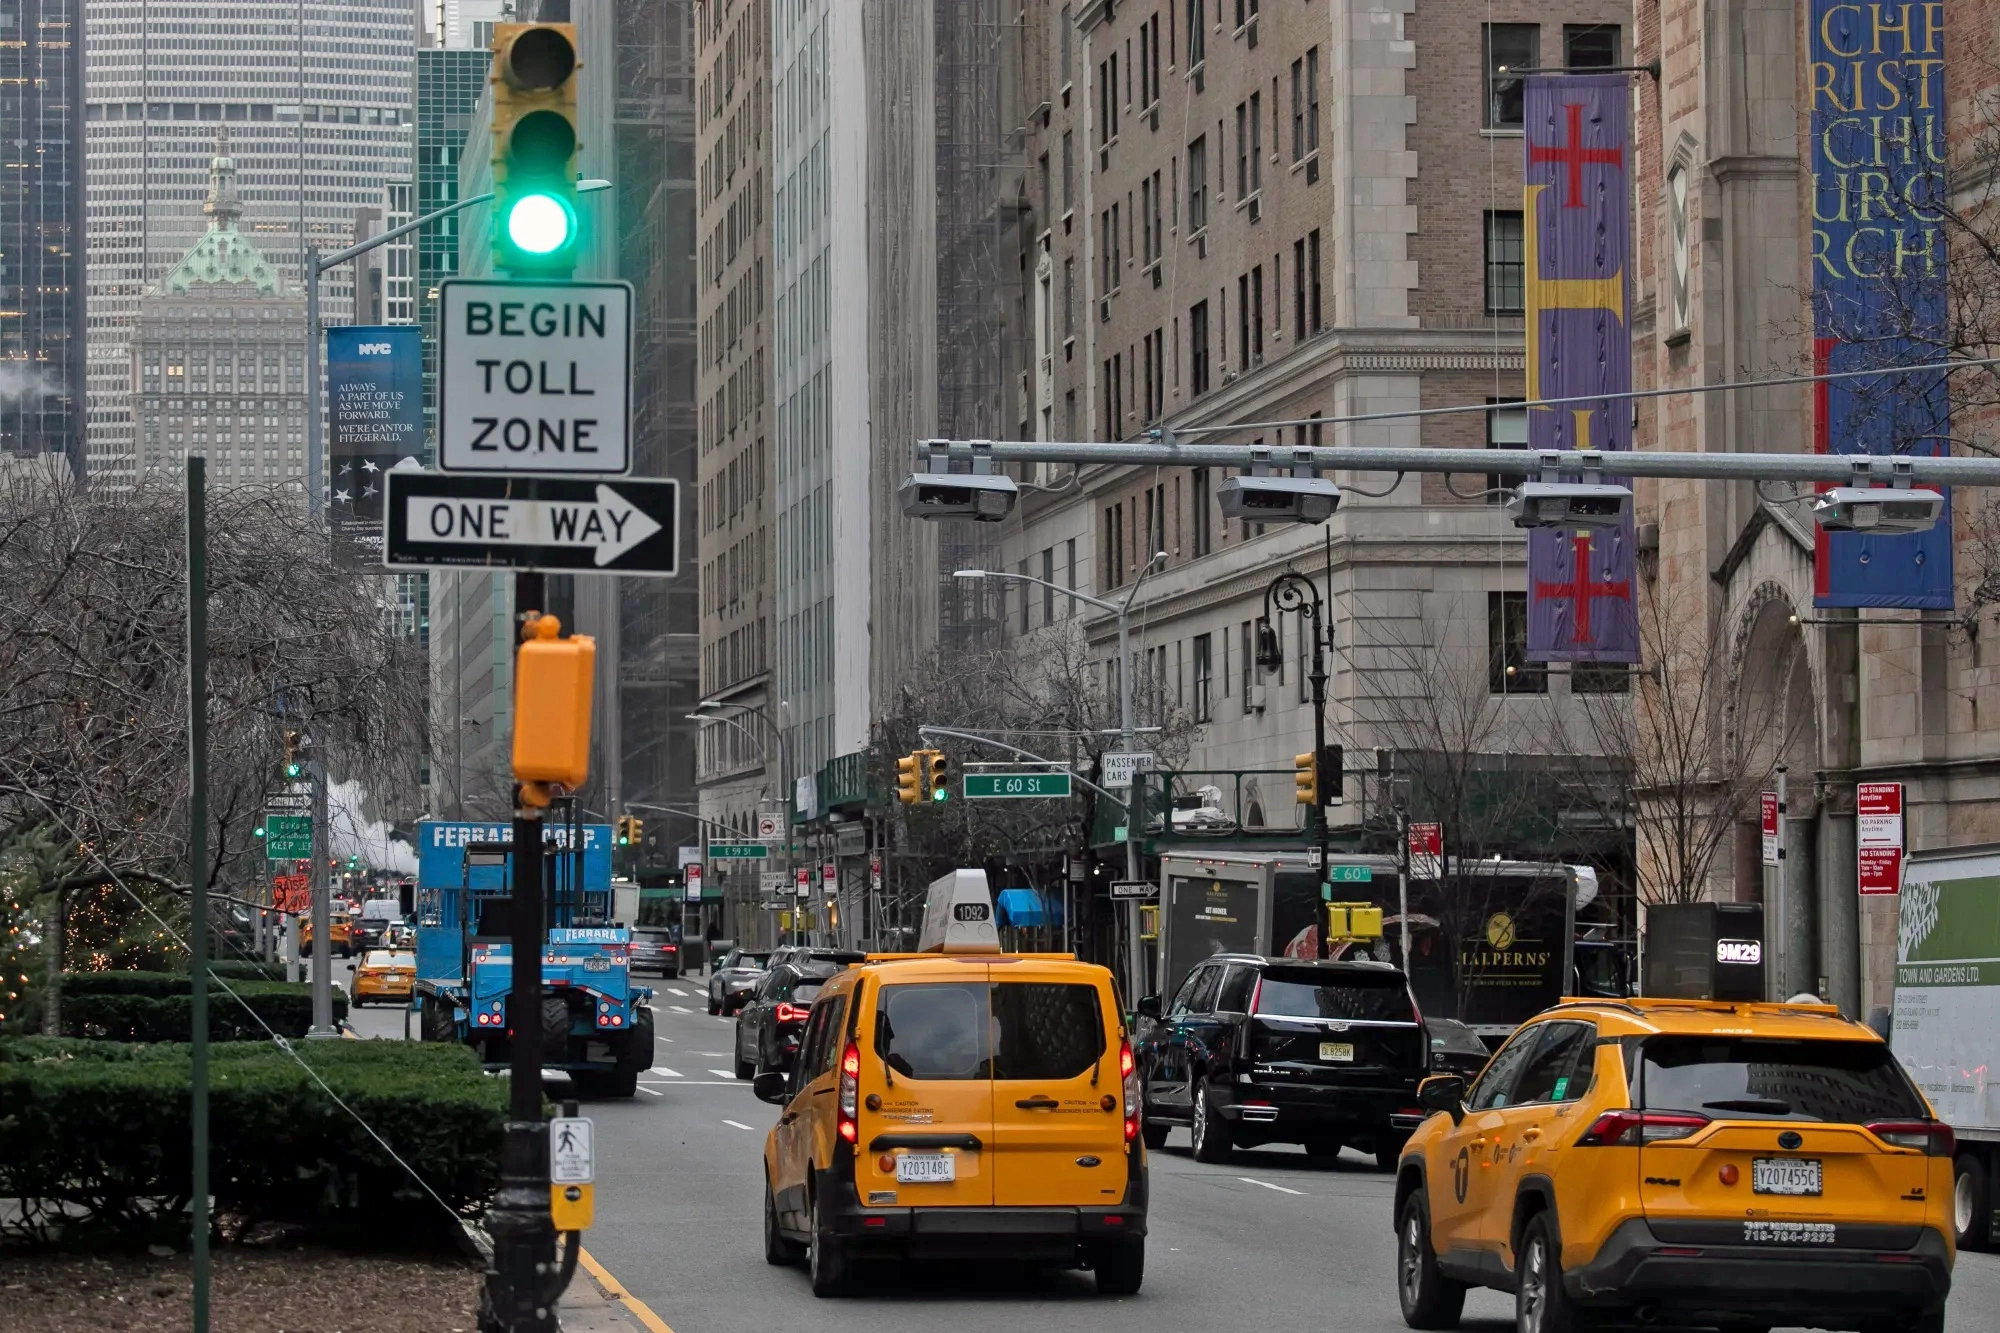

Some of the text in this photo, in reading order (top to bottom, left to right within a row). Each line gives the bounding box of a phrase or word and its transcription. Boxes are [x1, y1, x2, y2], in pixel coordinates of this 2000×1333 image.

[1811, 59, 1944, 112] RIST
[1812, 171, 1945, 222] URC
[1812, 227, 1938, 280] RCH
[466, 302, 606, 338] BEGIN
[358, 343, 392, 355] NYC
[476, 360, 595, 396] TOLL
[338, 382, 376, 392] ALWAYS
[338, 392, 404, 402] A PART OF US
[339, 401, 401, 411] AS WE MOVE
[339, 410, 391, 420] FORWARD.
[339, 423, 414, 433] WE'RE CANTOR
[339, 433, 402, 443] FITZGERALD.
[471, 417, 599, 453] ZONE
[430, 503, 633, 543] ONE WAY
[1106, 771, 1128, 781] CARS
[993, 778, 1041, 793] E 60 St
[1860, 794, 1882, 802] Anytime
[433, 826, 514, 847] FERRAR
[271, 841, 312, 851] KEEP LEF
[725, 847, 751, 856] E 59 St
[1331, 868, 1338, 880] E
[1344, 868, 1361, 880] 60
[1118, 886, 1154, 894] ONE WAY
[959, 905, 983, 920] 1D92
[565, 929, 618, 942] FERRARA
[1717, 943, 1761, 961] 9M29
[1899, 966, 1980, 984] TOWN AND GARDENS LTD.
[902, 1161, 949, 1176] Y203148C
[1760, 1167, 1815, 1186] Y207455C
[1744, 1230, 1836, 1243] 718-784-9292
